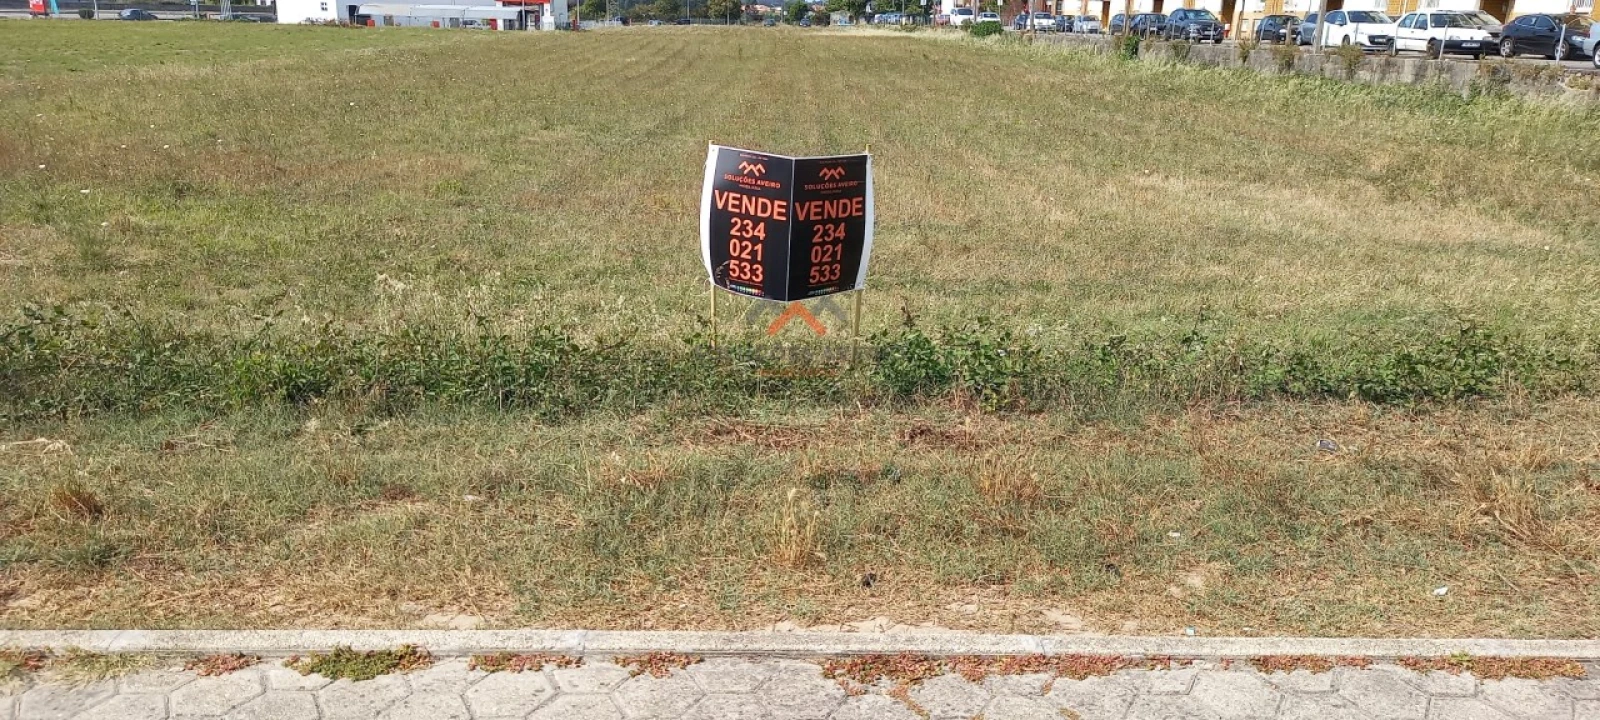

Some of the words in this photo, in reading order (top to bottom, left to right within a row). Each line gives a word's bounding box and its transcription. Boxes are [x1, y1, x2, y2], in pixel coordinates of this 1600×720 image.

[723, 173, 756, 185] SOLUÇÕES
[756, 178, 781, 189] AVEIRO
[804, 181, 837, 191] SOLUÇÕES
[838, 180, 858, 188] AVEIRO
[714, 190, 787, 221] VENDE
[795, 197, 863, 221] VENDE
[730, 218, 766, 240] 234
[813, 223, 846, 242] 234
[729, 239, 763, 261] 021
[811, 244, 842, 264] 021
[729, 260, 764, 282] 533
[809, 263, 841, 284] 533
